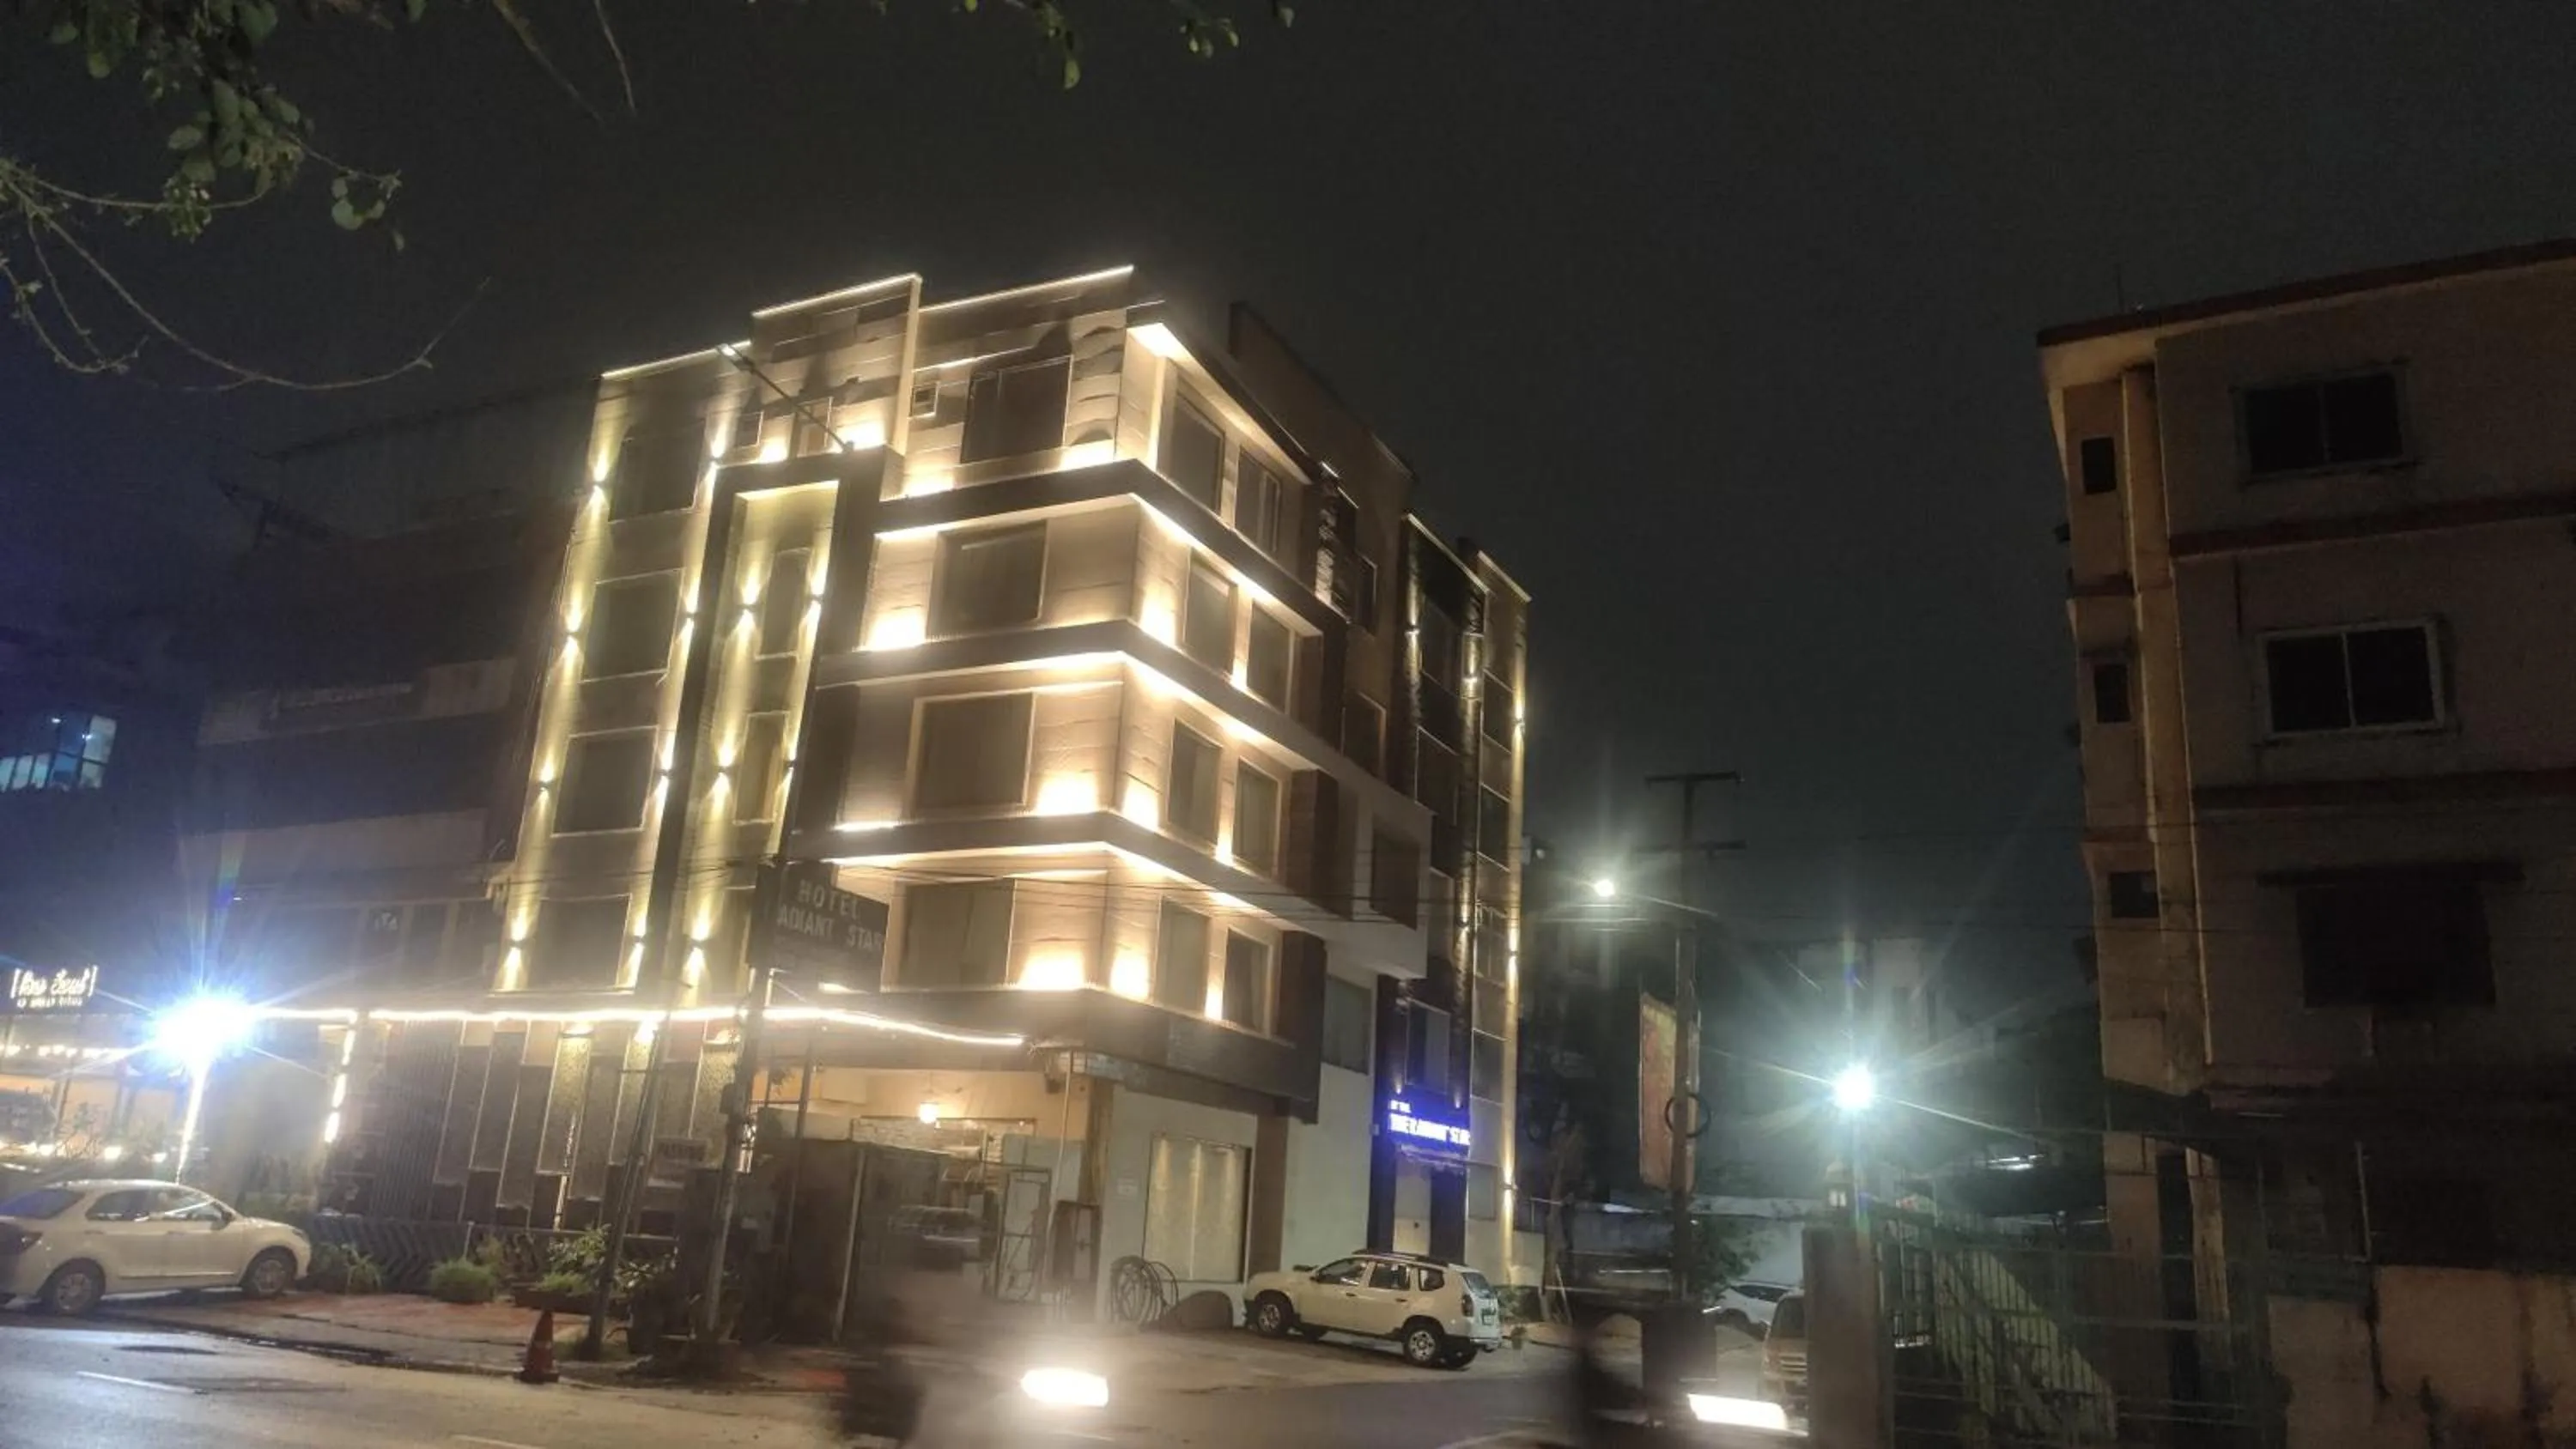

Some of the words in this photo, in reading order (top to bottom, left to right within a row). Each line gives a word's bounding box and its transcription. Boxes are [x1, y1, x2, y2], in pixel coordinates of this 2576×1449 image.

[798, 878, 859, 920] HOTEL
[776, 904, 835, 940] ADIANT
[846, 925, 884, 951] STAR
